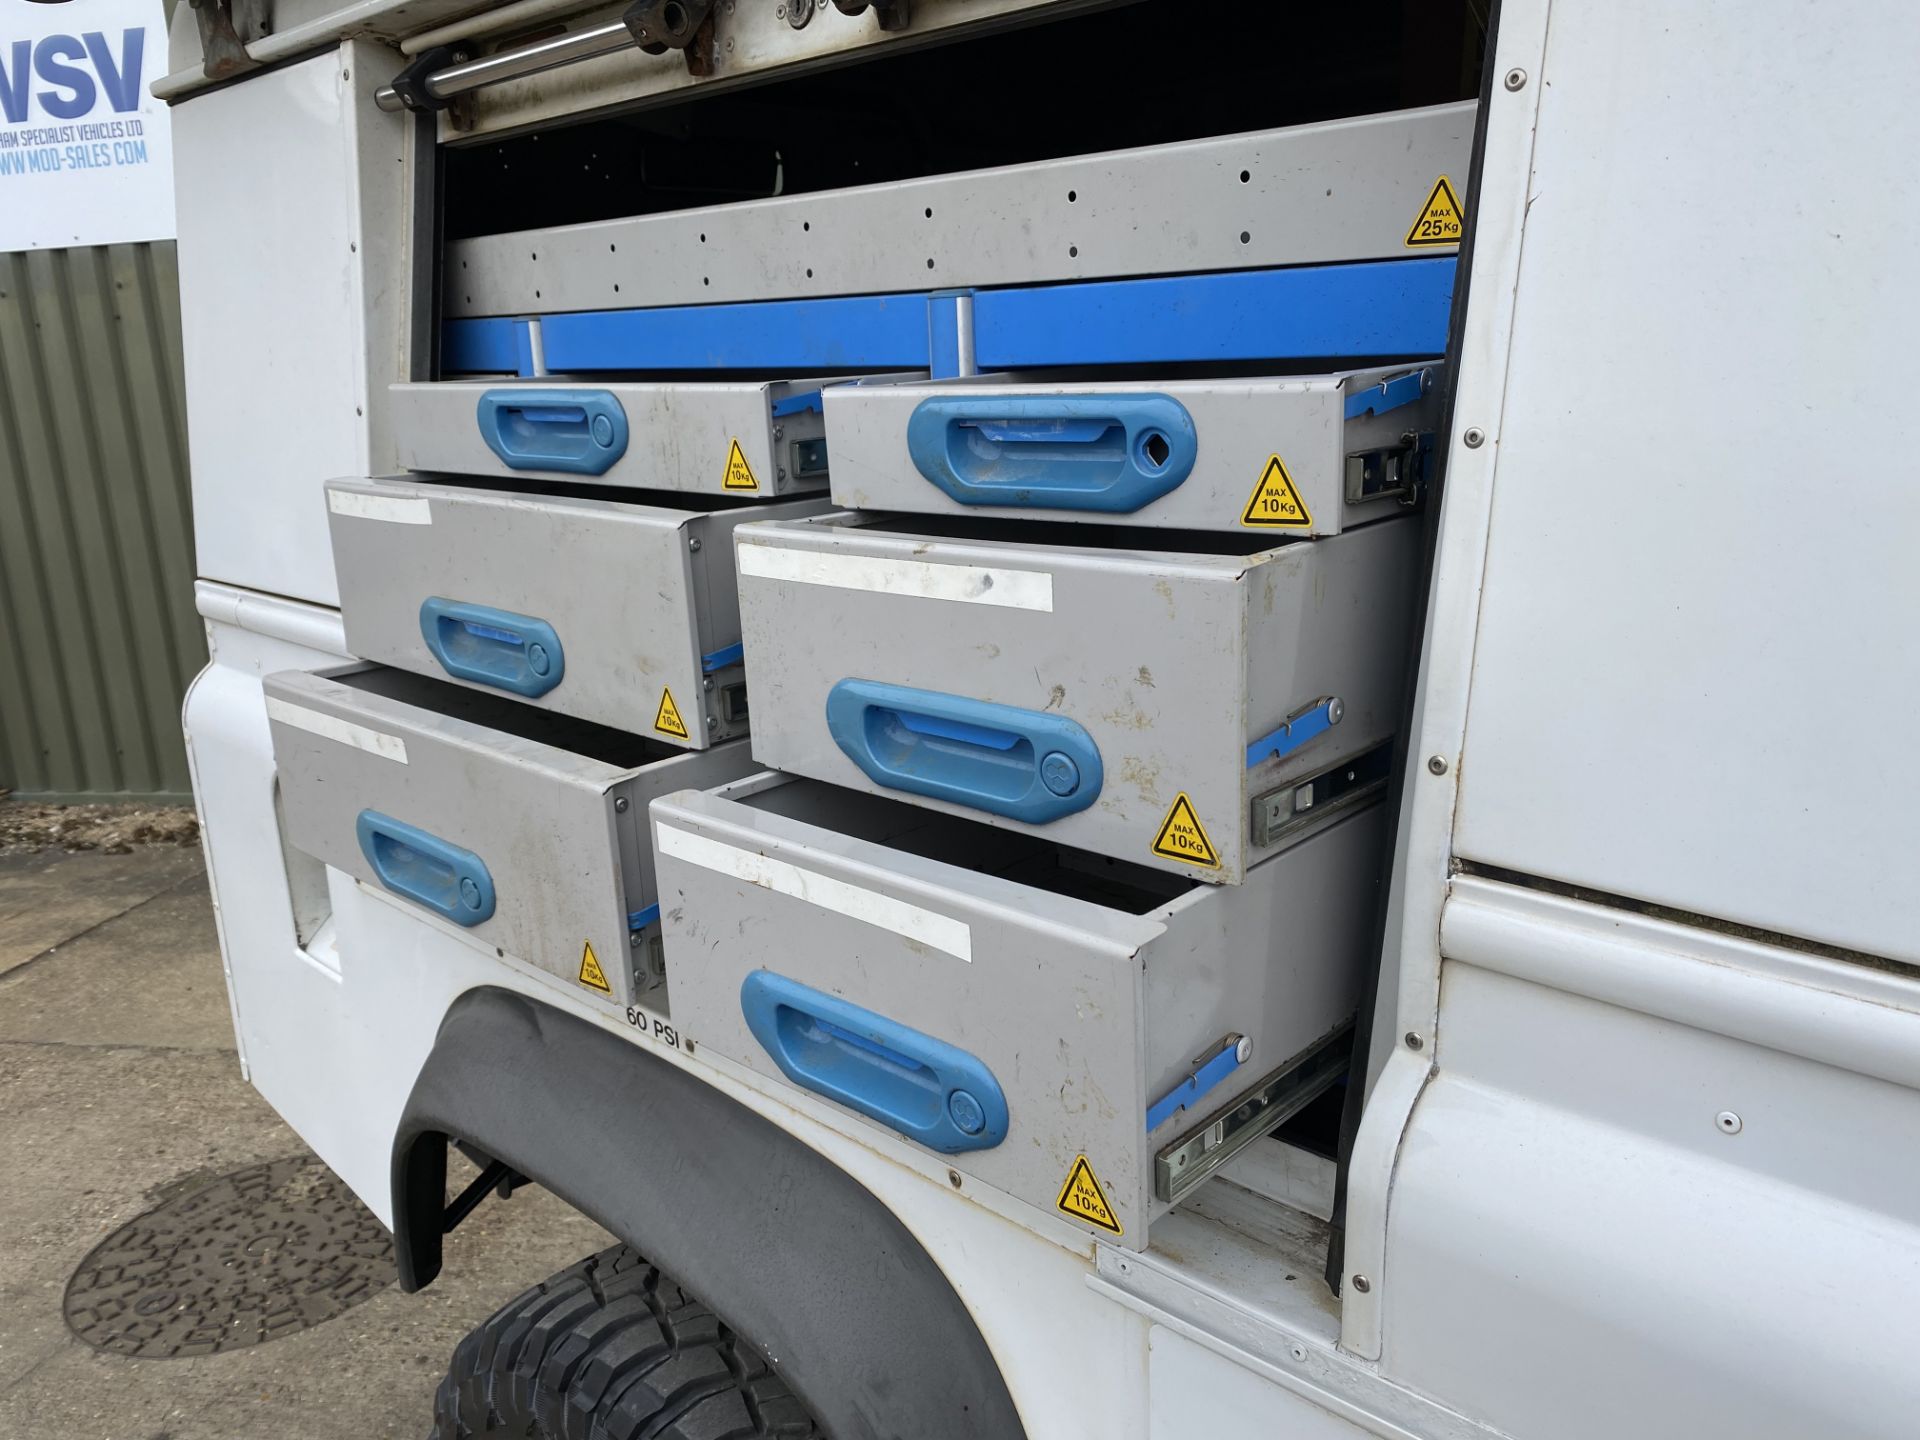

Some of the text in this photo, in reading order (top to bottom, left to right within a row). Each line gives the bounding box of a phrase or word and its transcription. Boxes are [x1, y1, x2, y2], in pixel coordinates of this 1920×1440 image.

[20, 125, 75, 147] SPECIALIST
[76, 121, 124, 142] VEHICLES
[125, 119, 143, 137] LTD
[1430, 208, 1451, 218] MAX
[1266, 488, 1287, 497] MAX
[1173, 823, 1195, 836] MAX
[626, 1006, 680, 1049] 60 PSI
[1077, 1183, 1096, 1199] MAX
